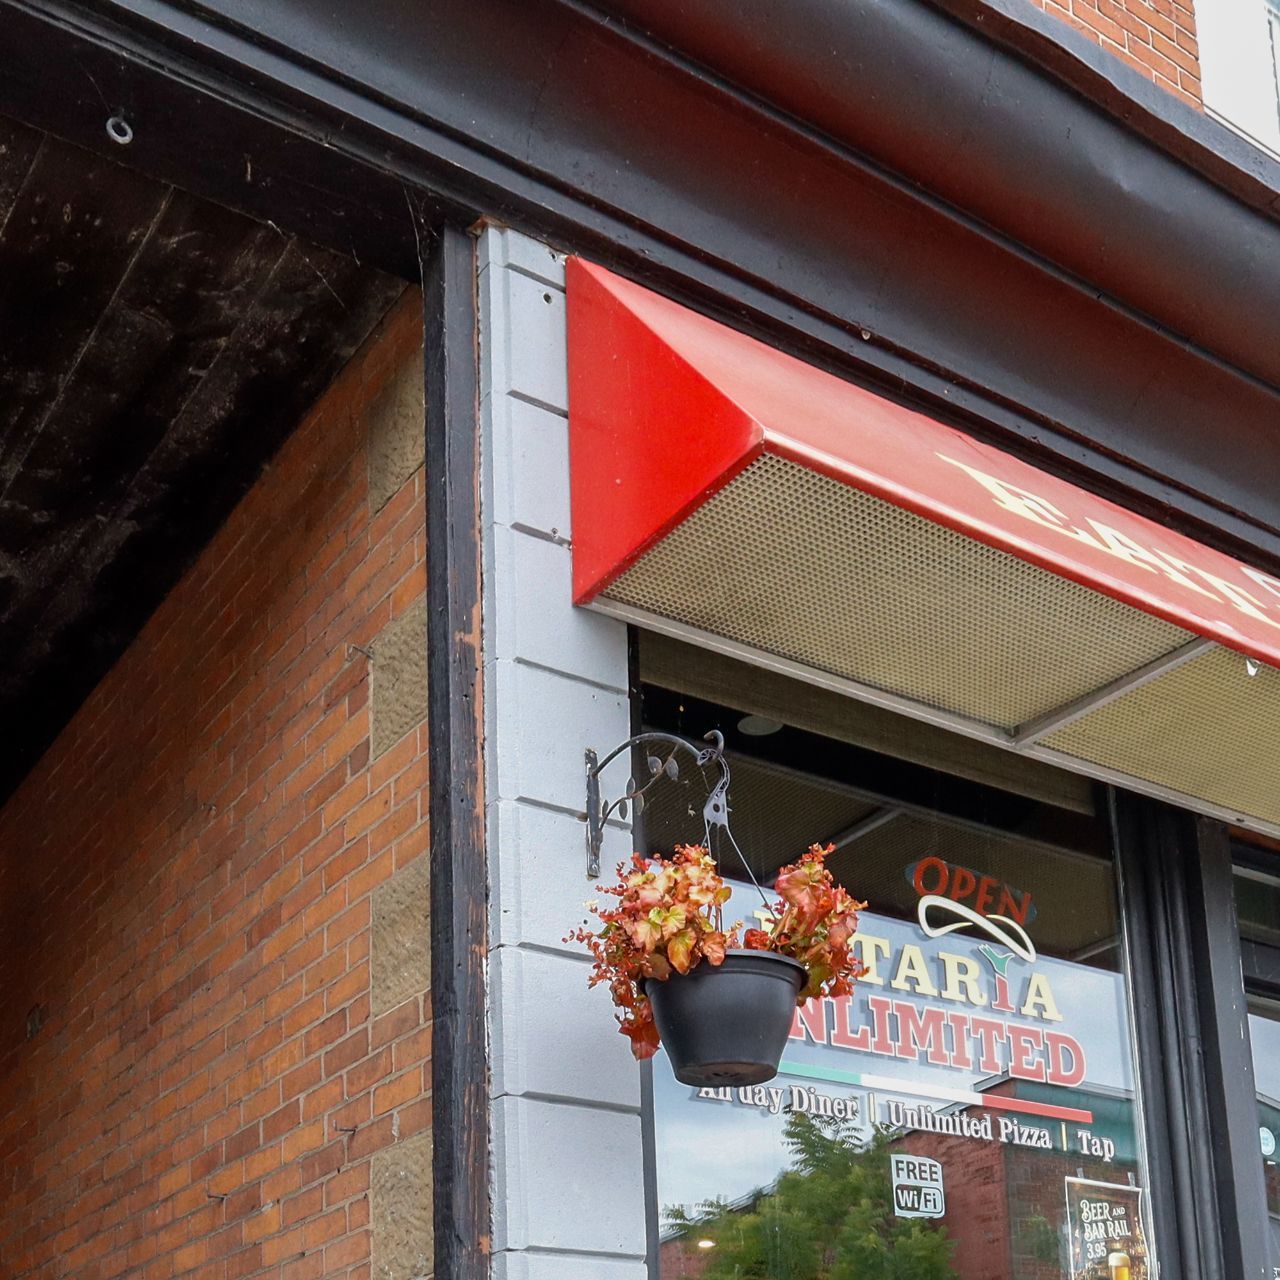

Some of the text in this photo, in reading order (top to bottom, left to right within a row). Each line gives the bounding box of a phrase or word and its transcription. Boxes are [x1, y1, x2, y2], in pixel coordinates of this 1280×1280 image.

[913, 856, 1032, 925] OPEN
[788, 995, 1086, 1088] NLIMITED
[789, 1085, 858, 1119] Diner
[887, 1100, 993, 1140] Unlimited
[998, 1116, 1052, 1149] Pizza
[1078, 1129, 1115, 1162] Tap
[895, 1160, 939, 1182] FREE
[1080, 1200, 1125, 1222] BEER AND
[1084, 1220, 1131, 1242] BAR RAIL
[1086, 1241, 1107, 1260] 3.95
